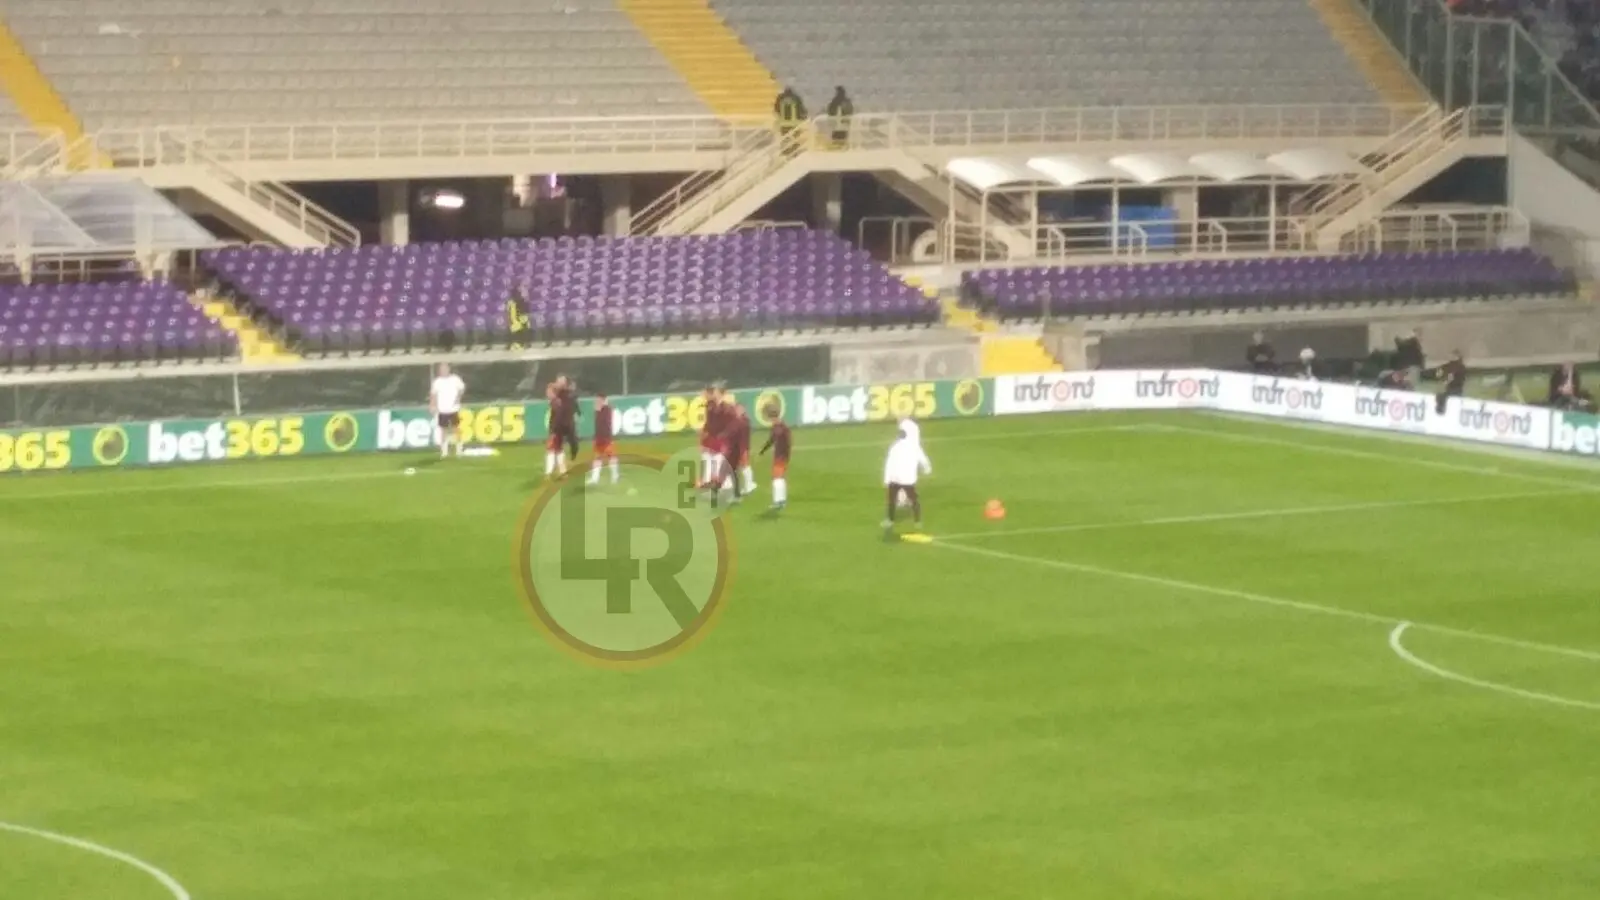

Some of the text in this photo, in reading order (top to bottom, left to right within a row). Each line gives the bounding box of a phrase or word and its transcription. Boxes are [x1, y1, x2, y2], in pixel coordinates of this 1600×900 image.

[801, 382, 937, 424] bet365
[1013, 376, 1095, 402] infront
[1136, 371, 1220, 399] infront
[1251, 375, 1323, 410] infront
[1354, 386, 1427, 422] infront
[147, 417, 304, 463] bet365
[377, 405, 525, 449] be365
